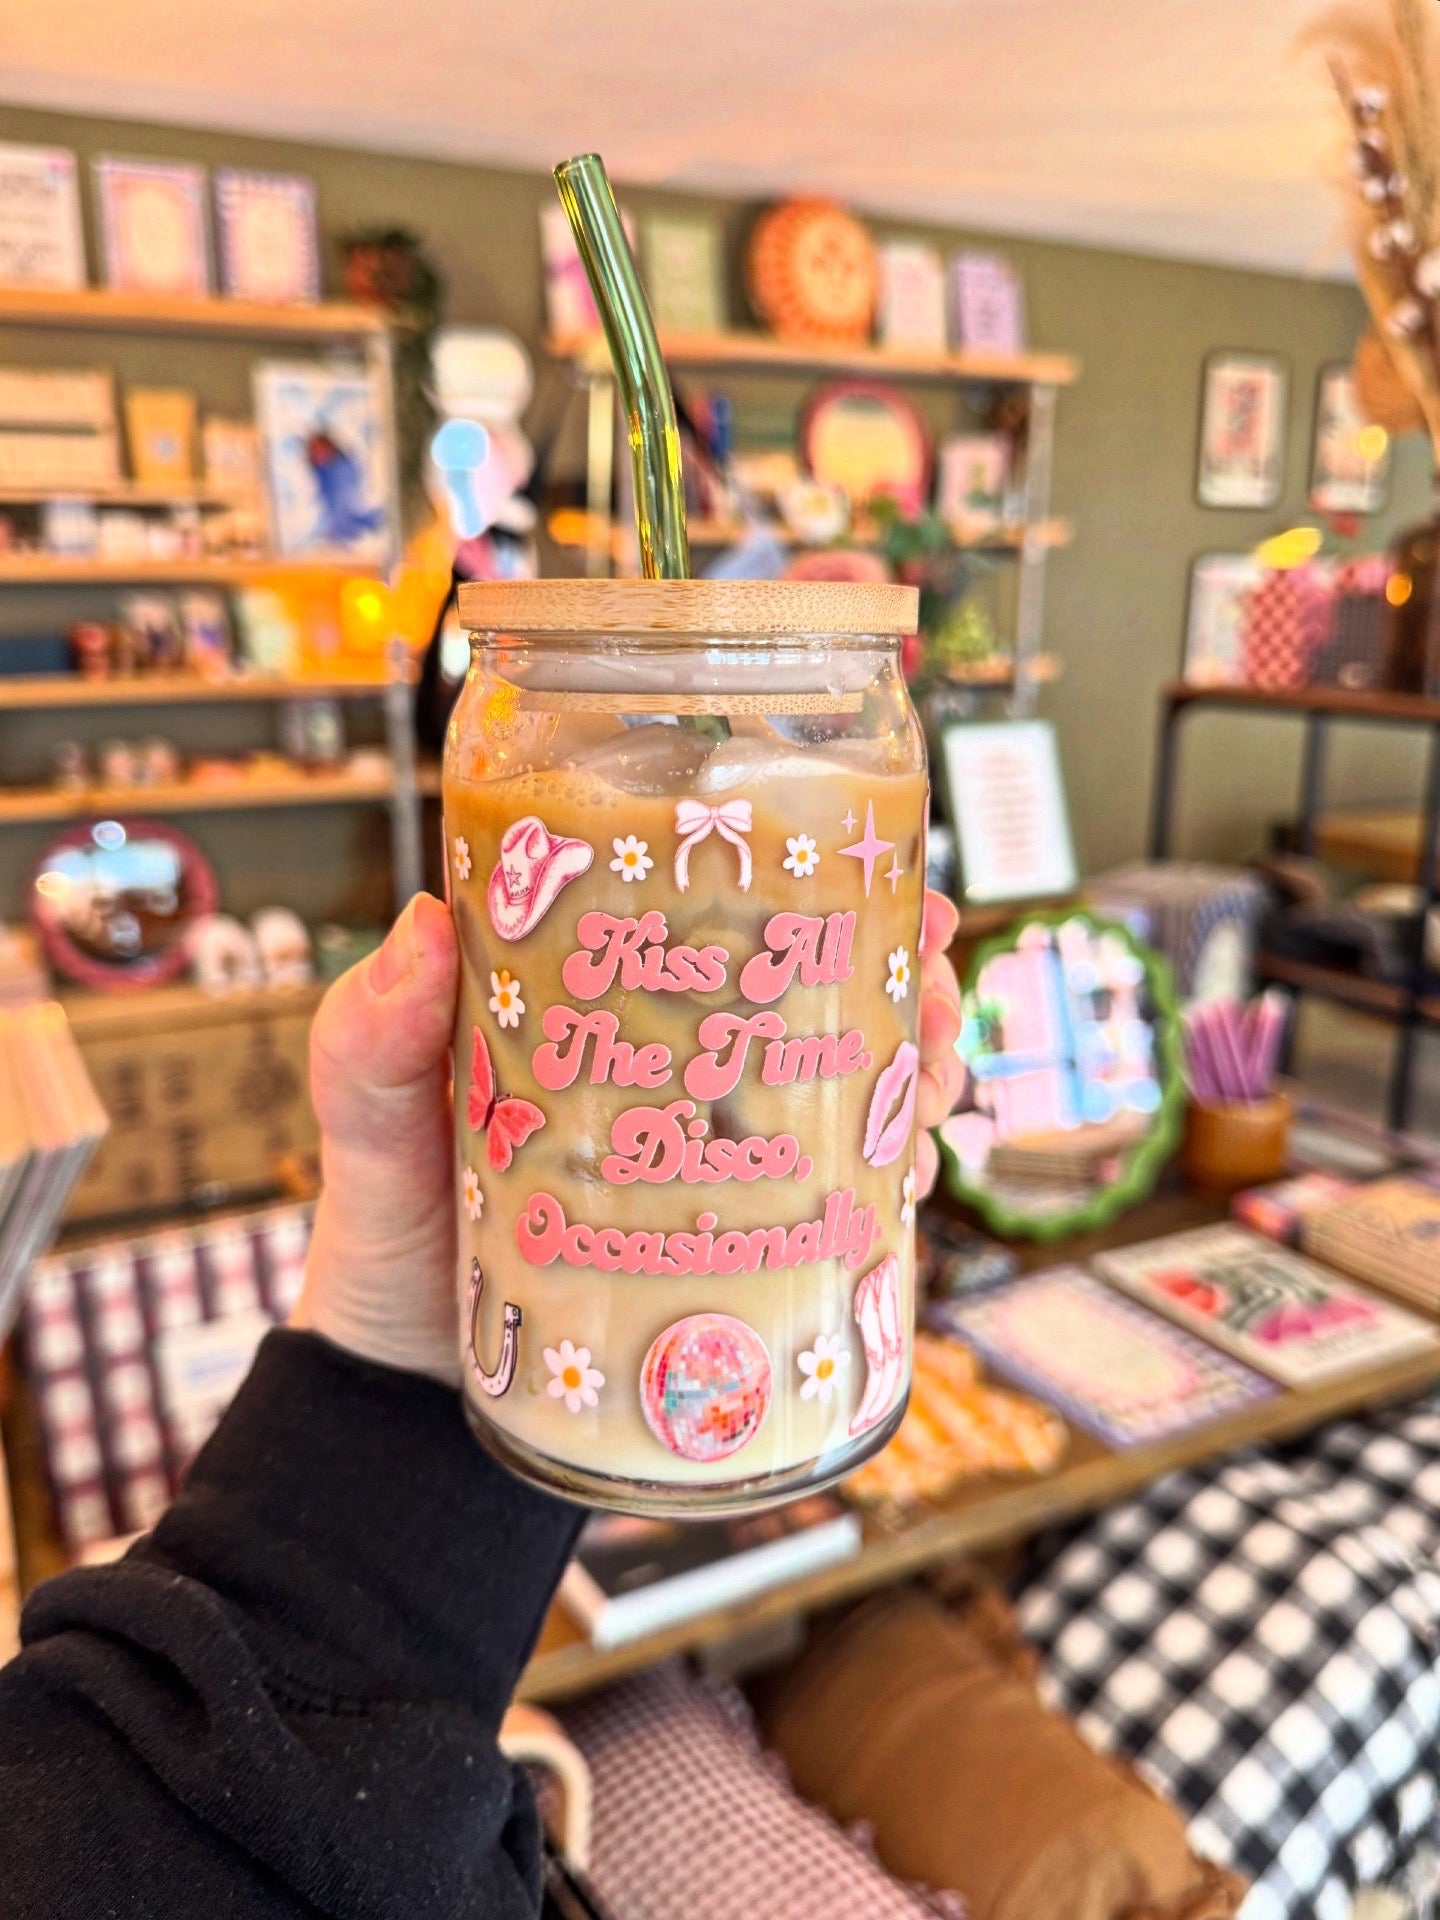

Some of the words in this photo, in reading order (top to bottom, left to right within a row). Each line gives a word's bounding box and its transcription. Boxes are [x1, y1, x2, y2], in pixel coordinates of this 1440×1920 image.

[562, 910, 730, 1000] Kiss
[739, 910, 855, 1004] All
[532, 1004, 673, 1091] The
[600, 1100, 814, 1185] Disco,
